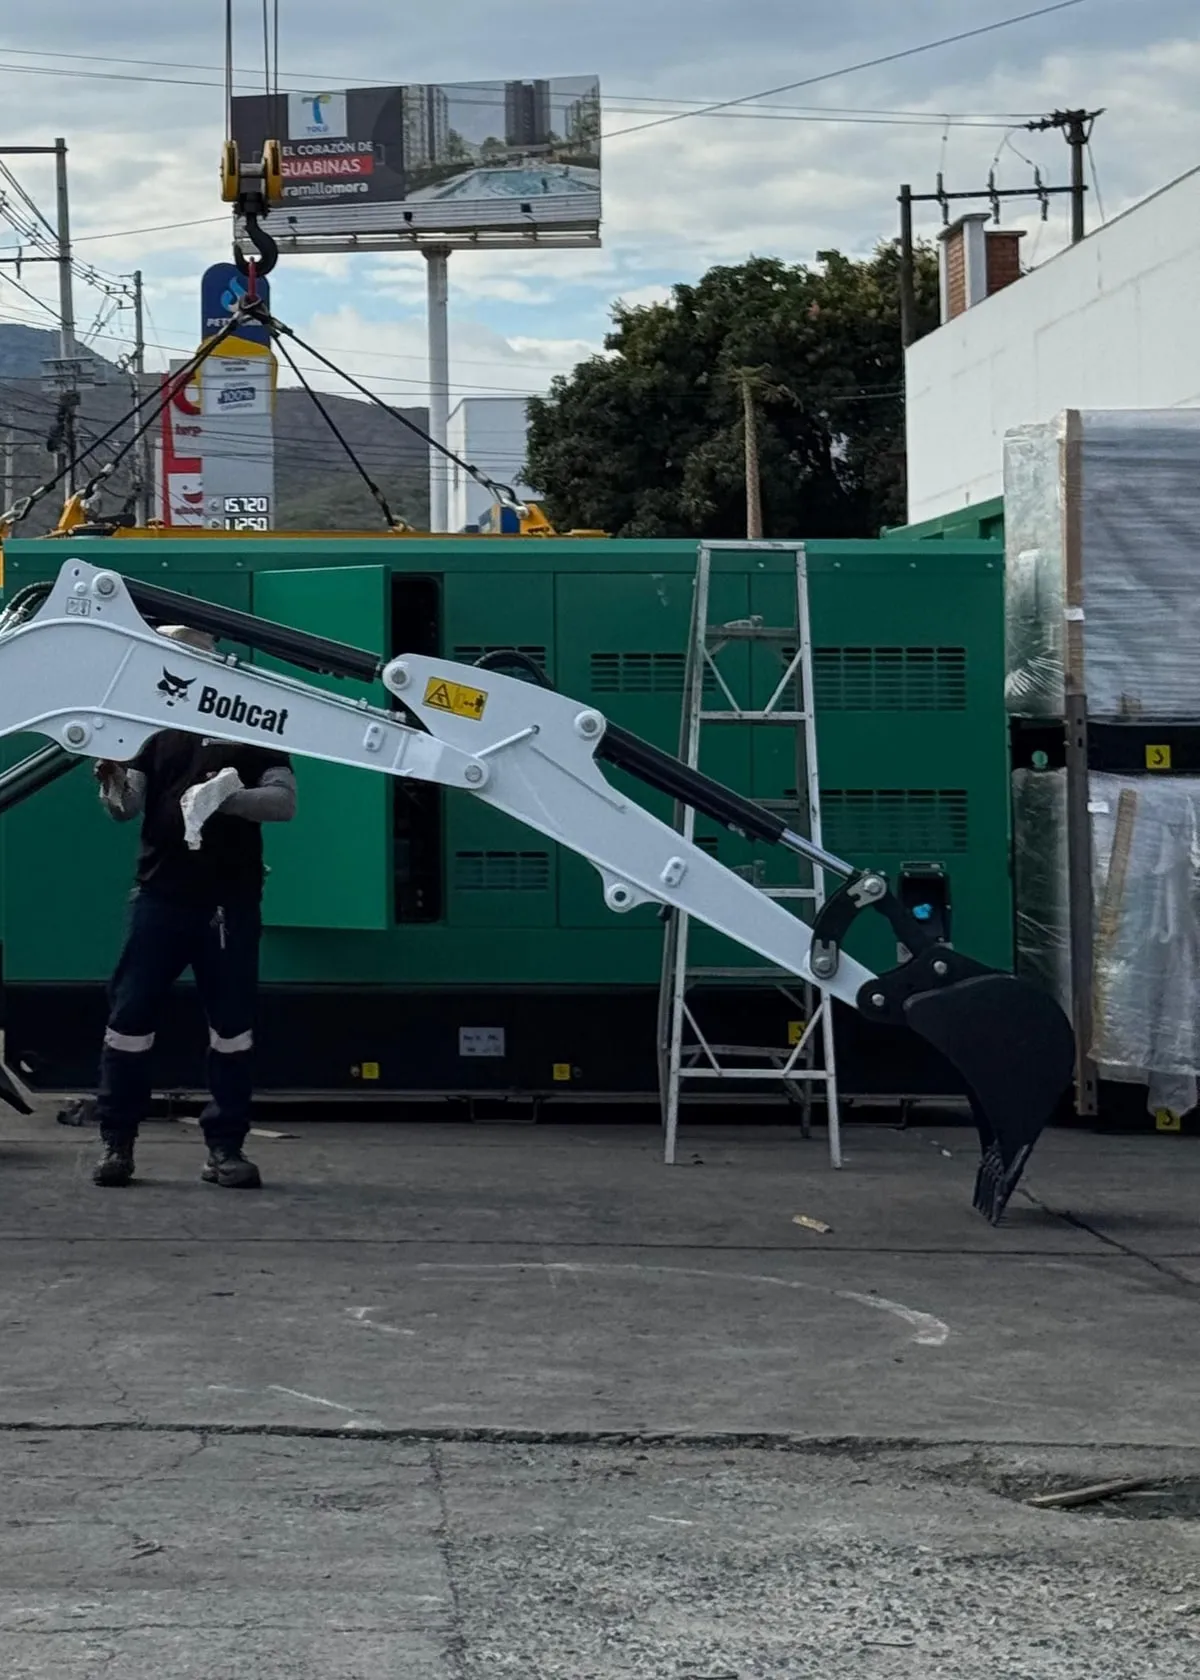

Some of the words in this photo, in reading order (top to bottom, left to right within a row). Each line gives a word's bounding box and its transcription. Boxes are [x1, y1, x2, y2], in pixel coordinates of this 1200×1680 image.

[283, 146, 296, 156] EL
[297, 141, 356, 155] CORAZÓN
[358, 141, 374, 152] DE
[280, 159, 361, 177] GUABINAS
[197, 686, 289, 735] Bobcat
